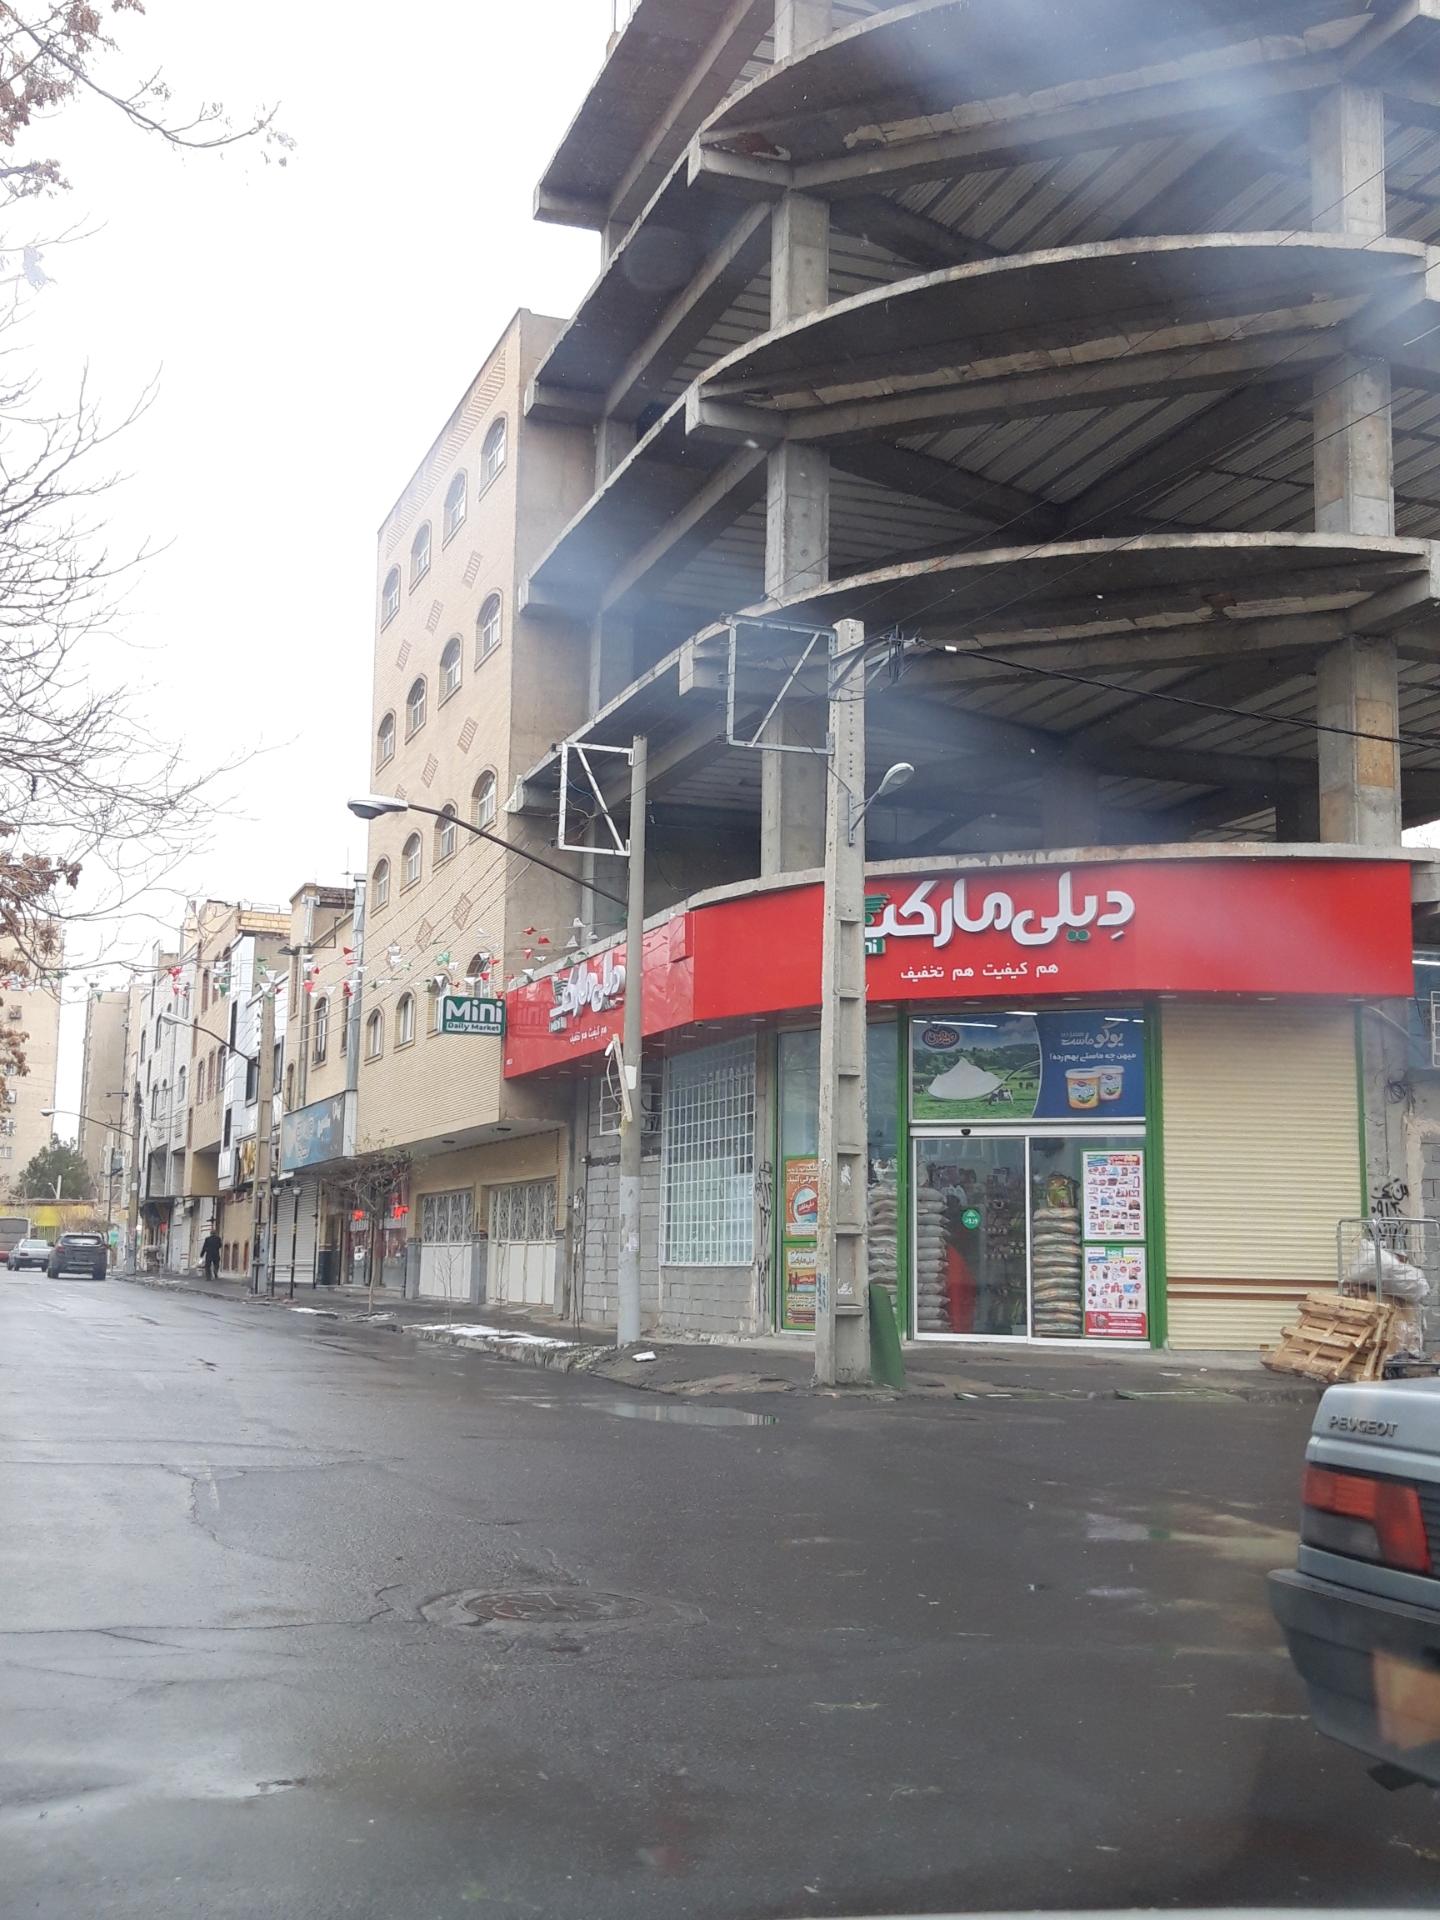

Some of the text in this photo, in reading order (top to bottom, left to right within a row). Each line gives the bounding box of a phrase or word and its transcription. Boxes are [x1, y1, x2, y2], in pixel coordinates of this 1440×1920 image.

[900, 962, 1059, 983] هم کیفیت هم تخفیف
[446, 1000, 502, 1022] Mini
[448, 1023, 499, 1032] Daily Market
[1328, 1415, 1398, 1437] PEUGEOT
